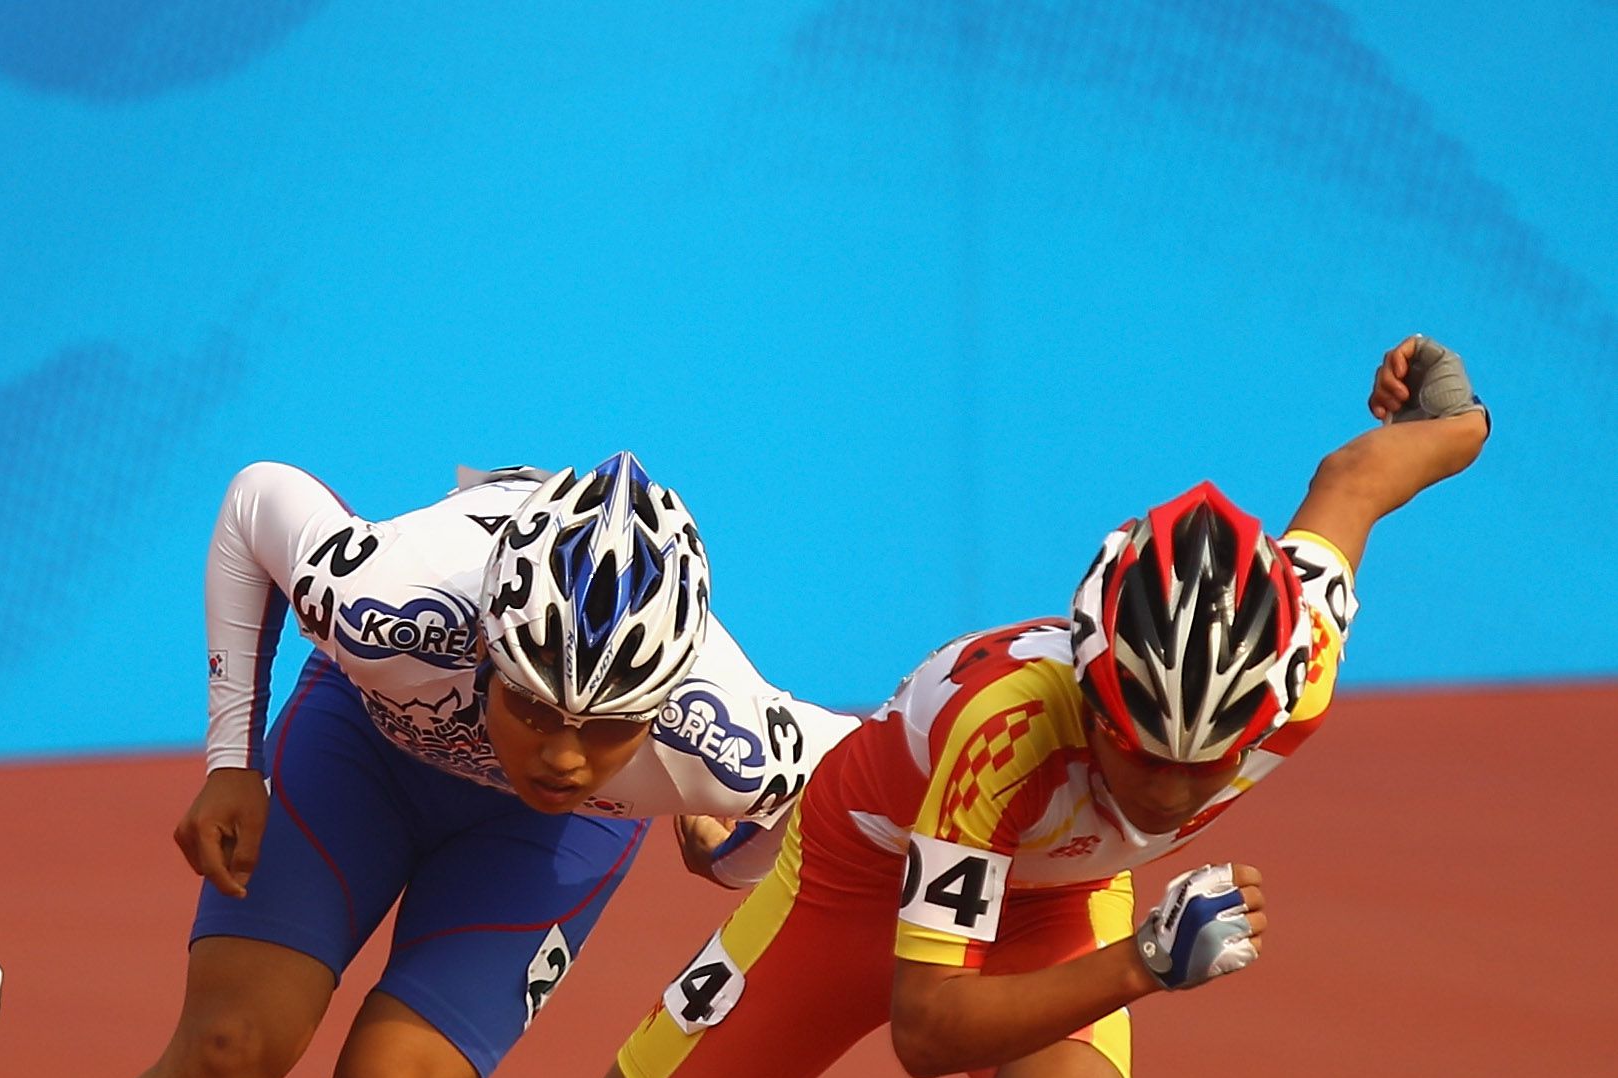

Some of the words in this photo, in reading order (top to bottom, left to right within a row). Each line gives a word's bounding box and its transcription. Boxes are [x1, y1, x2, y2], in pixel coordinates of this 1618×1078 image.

[293, 526, 380, 641] 23
[588, 645, 614, 694] RUDY
[658, 700, 742, 774] OREA
[680, 962, 732, 1022] 4
